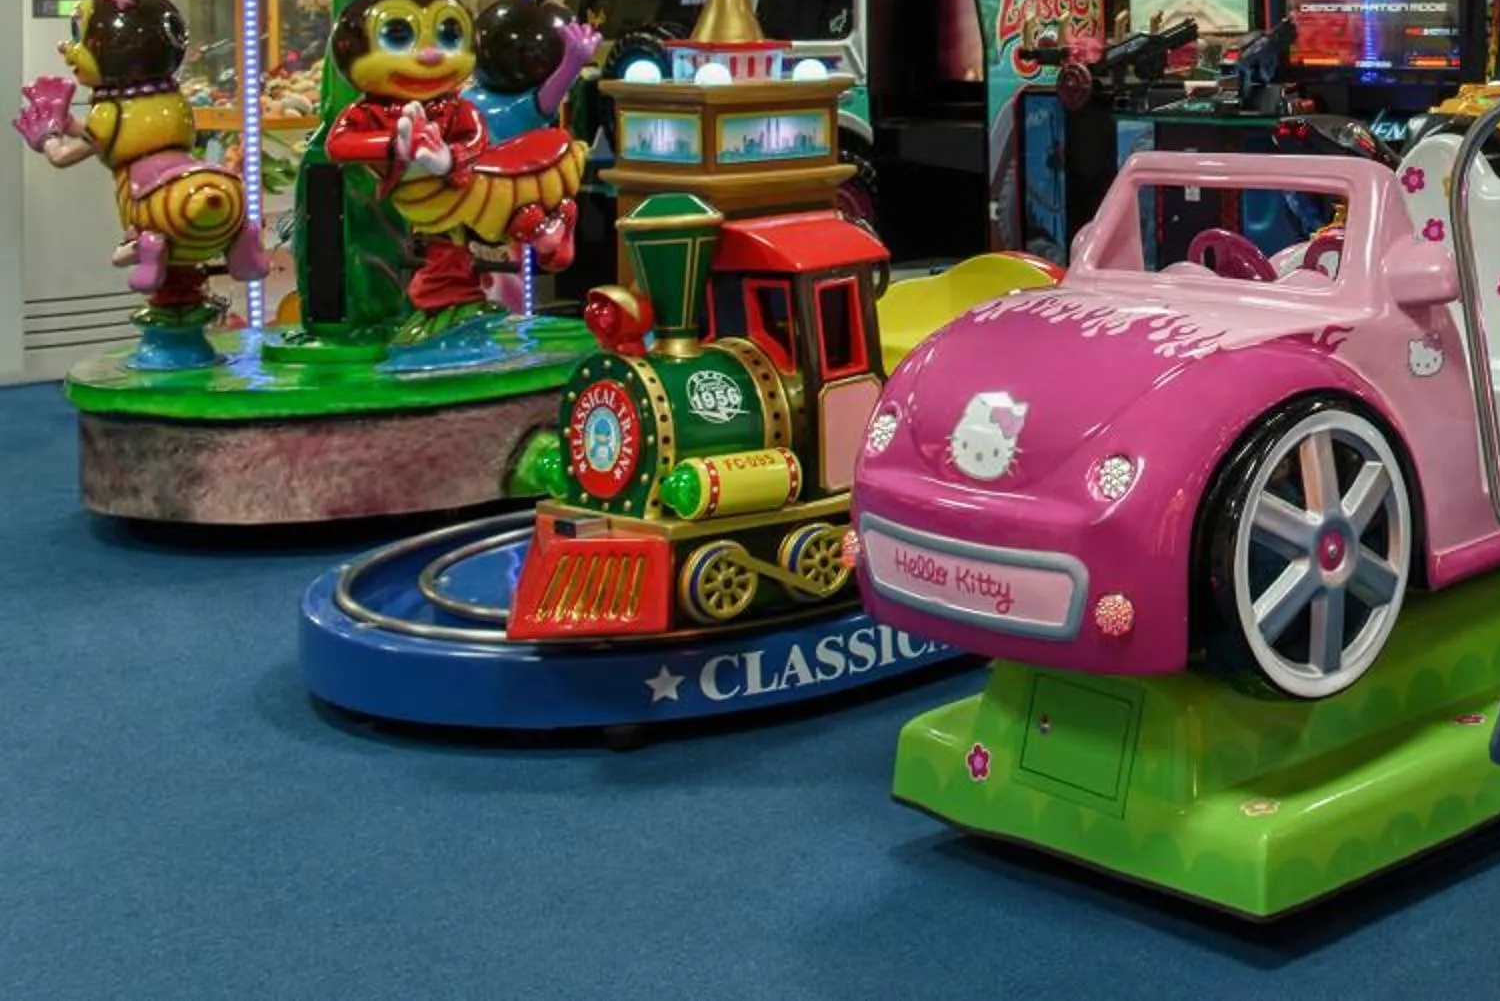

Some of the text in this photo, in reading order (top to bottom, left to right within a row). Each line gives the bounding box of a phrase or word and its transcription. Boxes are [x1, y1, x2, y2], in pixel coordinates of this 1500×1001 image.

[573, 388, 616, 460] CLASSICAL
[692, 386, 741, 411] 1956
[894, 547, 1015, 614] Hello Kitty
[700, 624, 949, 701] CLASSIC
